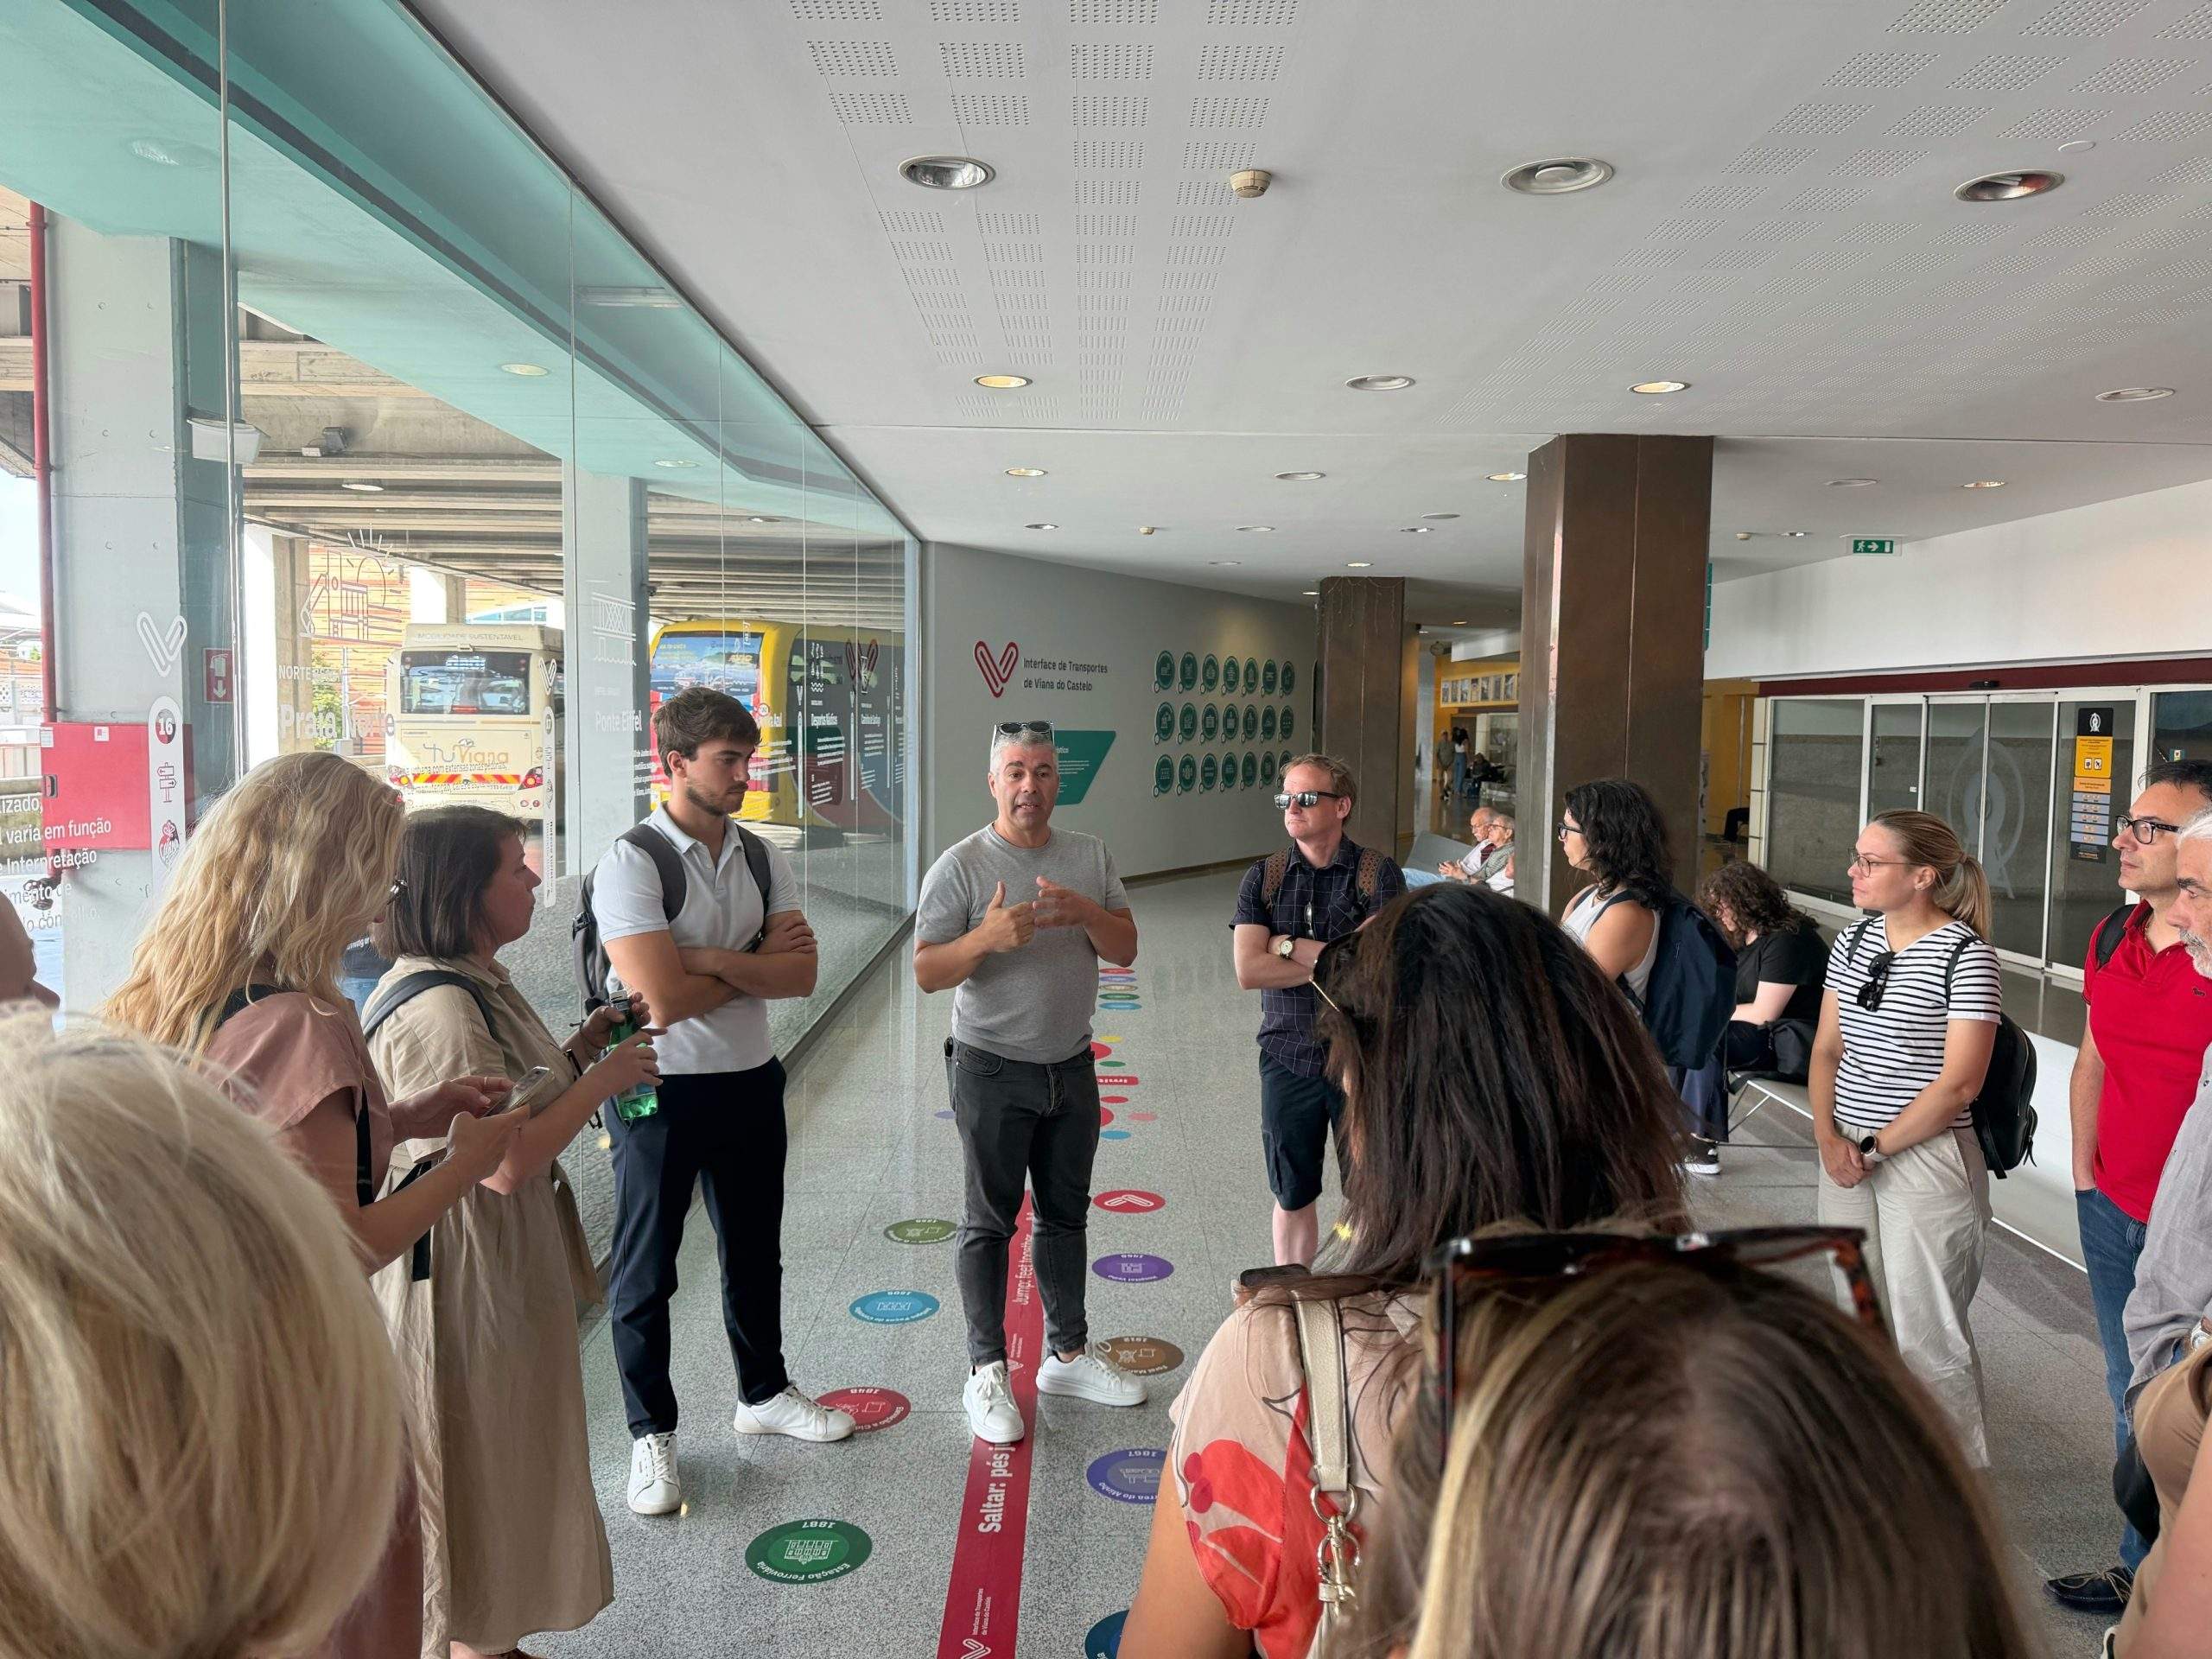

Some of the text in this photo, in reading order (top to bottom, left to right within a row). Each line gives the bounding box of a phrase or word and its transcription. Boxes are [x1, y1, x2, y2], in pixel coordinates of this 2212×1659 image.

[1023, 658, 1108, 675] Interface de Transportes
[1023, 678, 1093, 691] de Viana do Castelo
[158, 717, 174, 735] 16
[595, 710, 620, 732] Ponte
[0, 796, 43, 815] izado,
[6, 817, 111, 844] varia em função
[7, 847, 98, 874] Interpretação
[985, 1452, 1014, 1478] pés
[1098, 1482, 1122, 1497] Minho
[977, 1482, 1007, 1534] Saltar:
[757, 1560, 851, 1581] Estação Ferroviária
